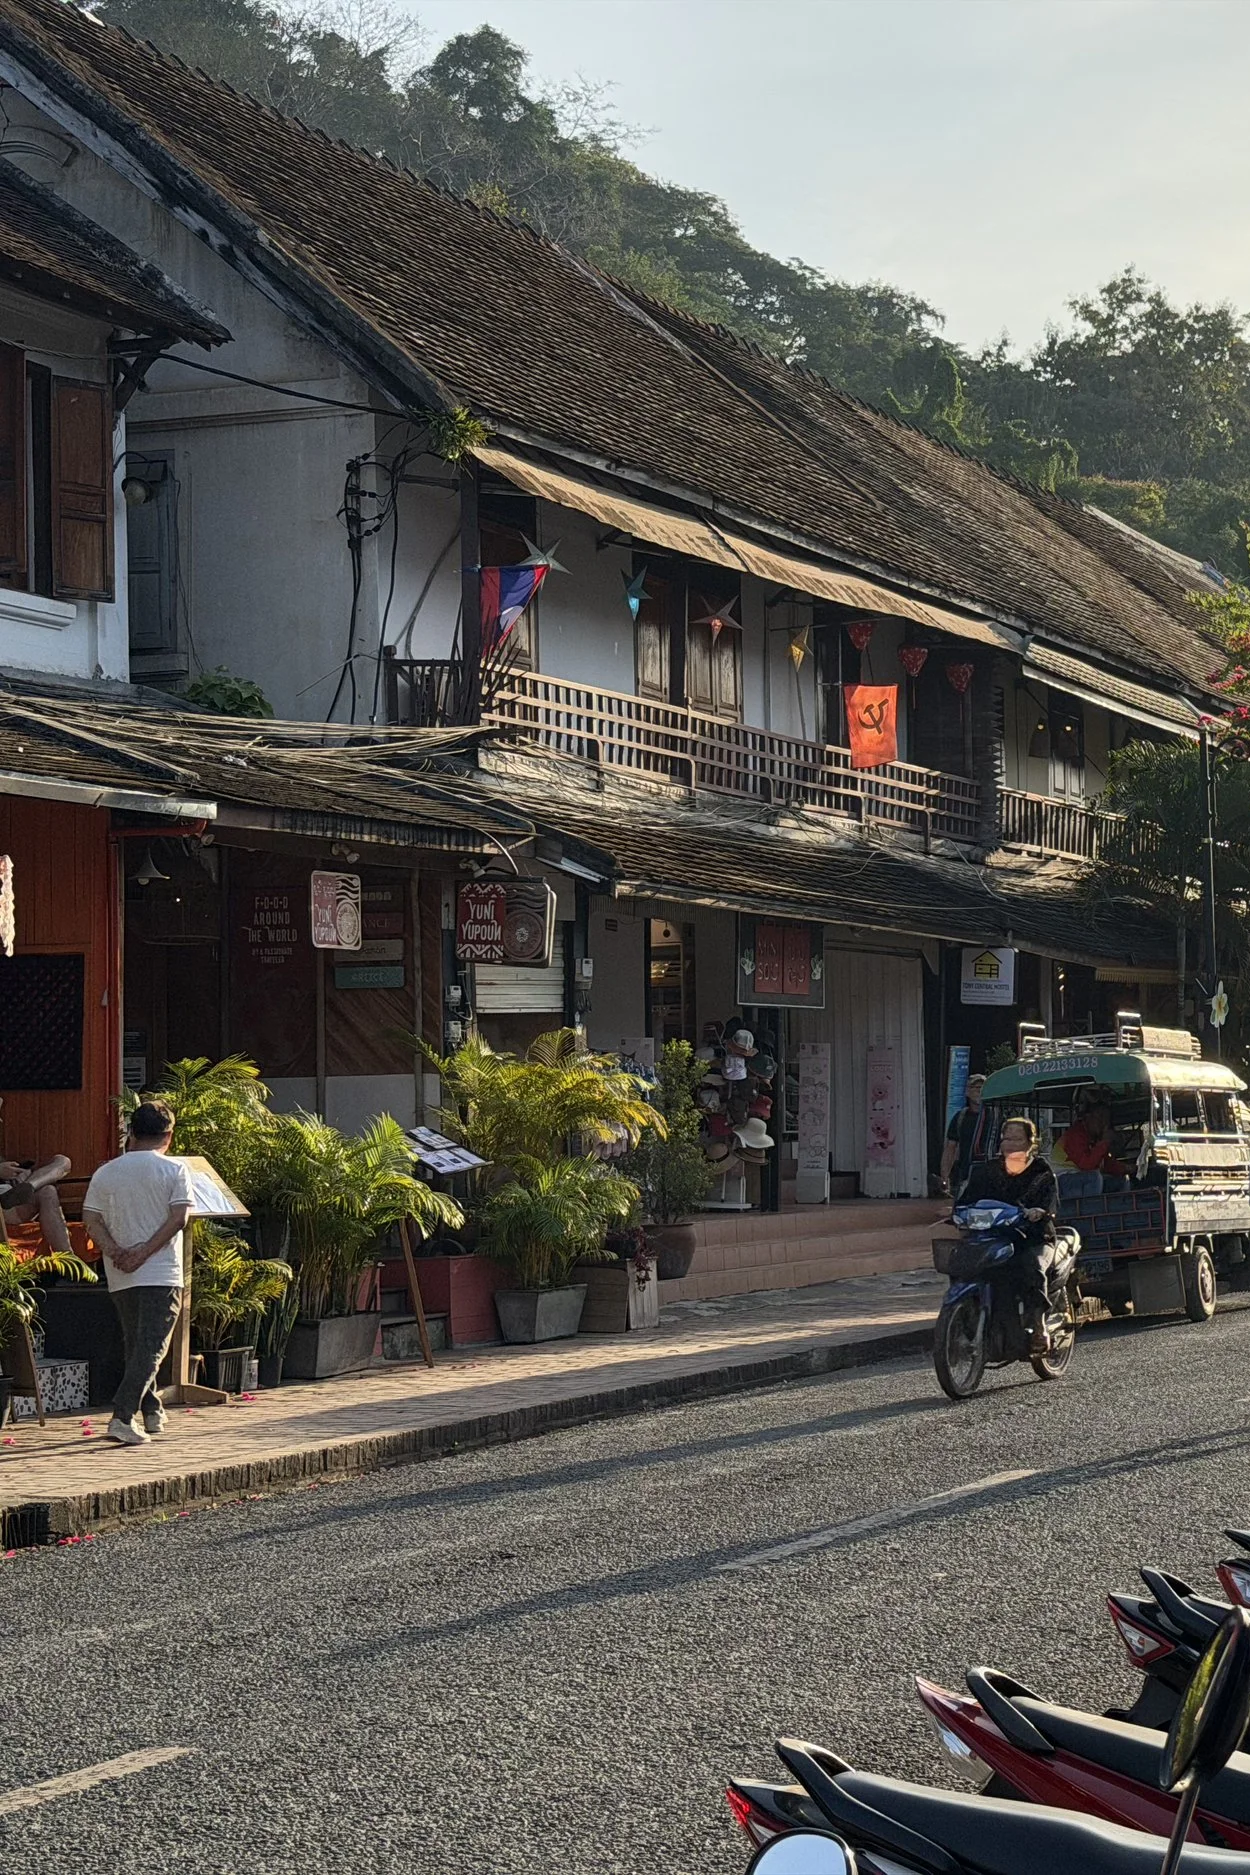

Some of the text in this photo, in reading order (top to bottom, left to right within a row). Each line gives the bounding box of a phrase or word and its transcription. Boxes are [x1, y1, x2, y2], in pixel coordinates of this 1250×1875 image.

[254, 911, 290, 925] AROUND
[241, 926, 297, 943] THE WORLD
